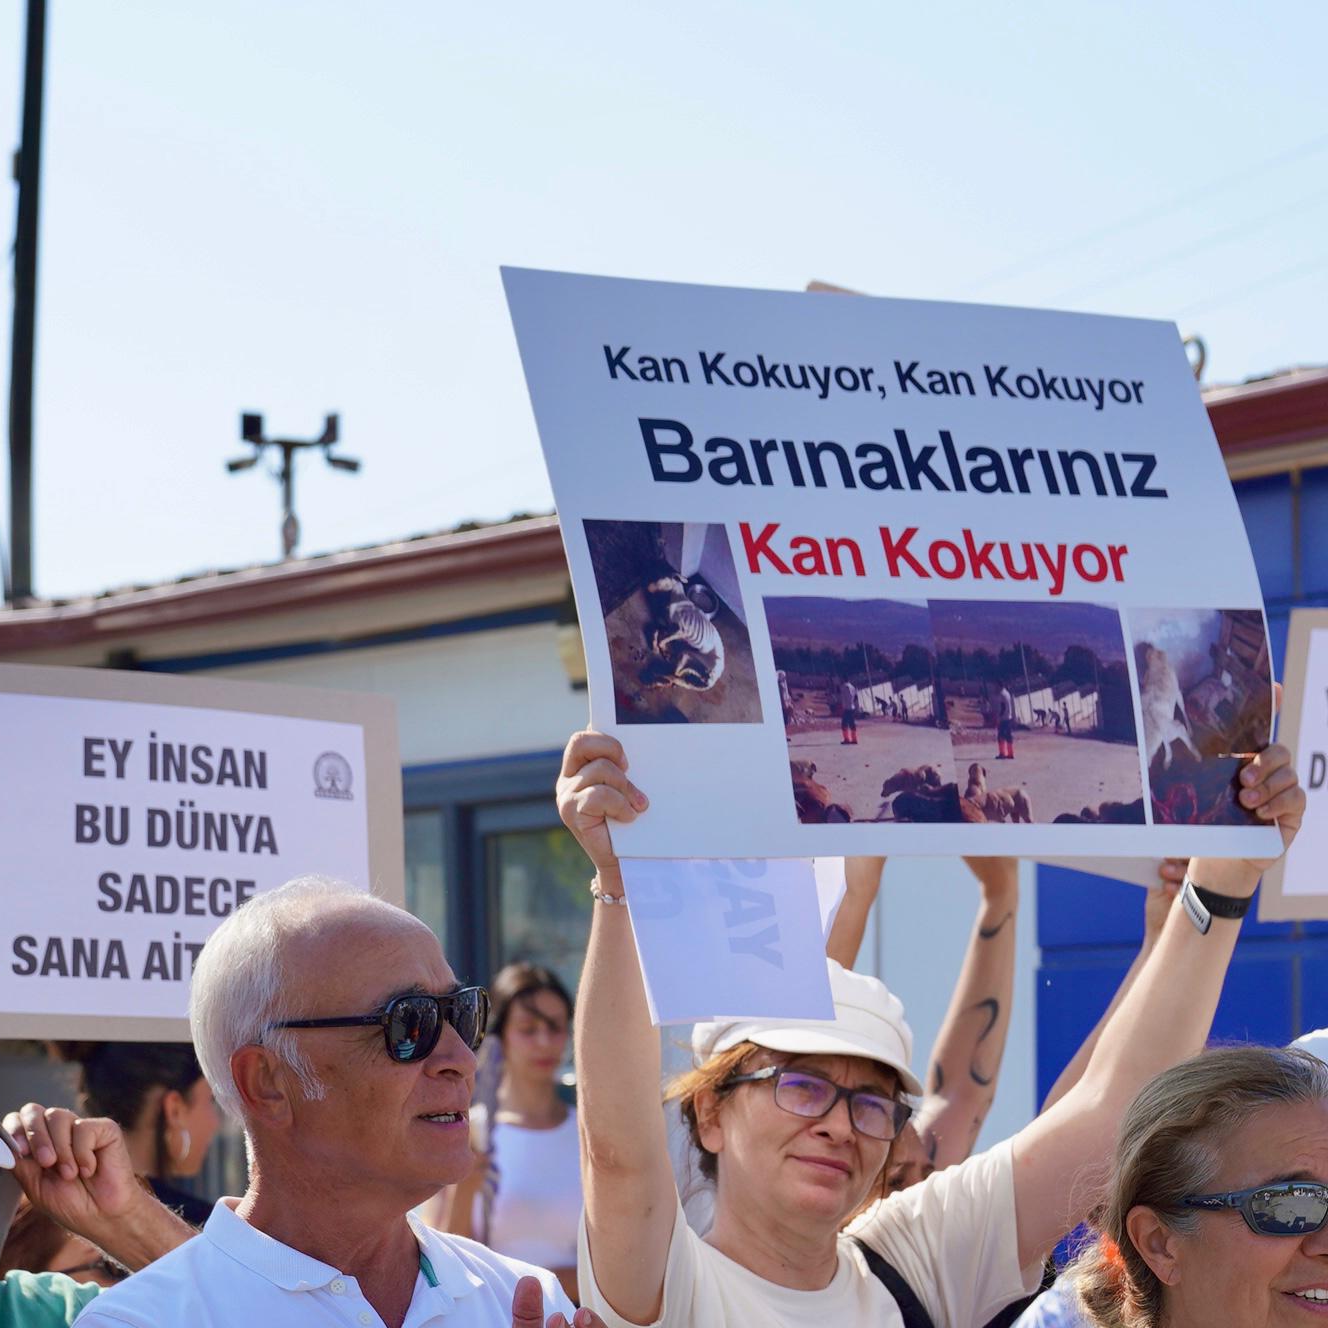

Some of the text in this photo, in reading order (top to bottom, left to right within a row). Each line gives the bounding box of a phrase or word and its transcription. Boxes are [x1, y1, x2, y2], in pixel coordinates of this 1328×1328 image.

[602, 344, 1146, 412] Kan Kokuyor, Kan Kokuyor
[636, 416, 1169, 501] Barınaklarınız
[738, 521, 1129, 597] Kan Kokuyor
[82, 731, 269, 791] EY İNSAN
[75, 799, 280, 856] BU DÜNYA
[11, 934, 130, 980] SANA
